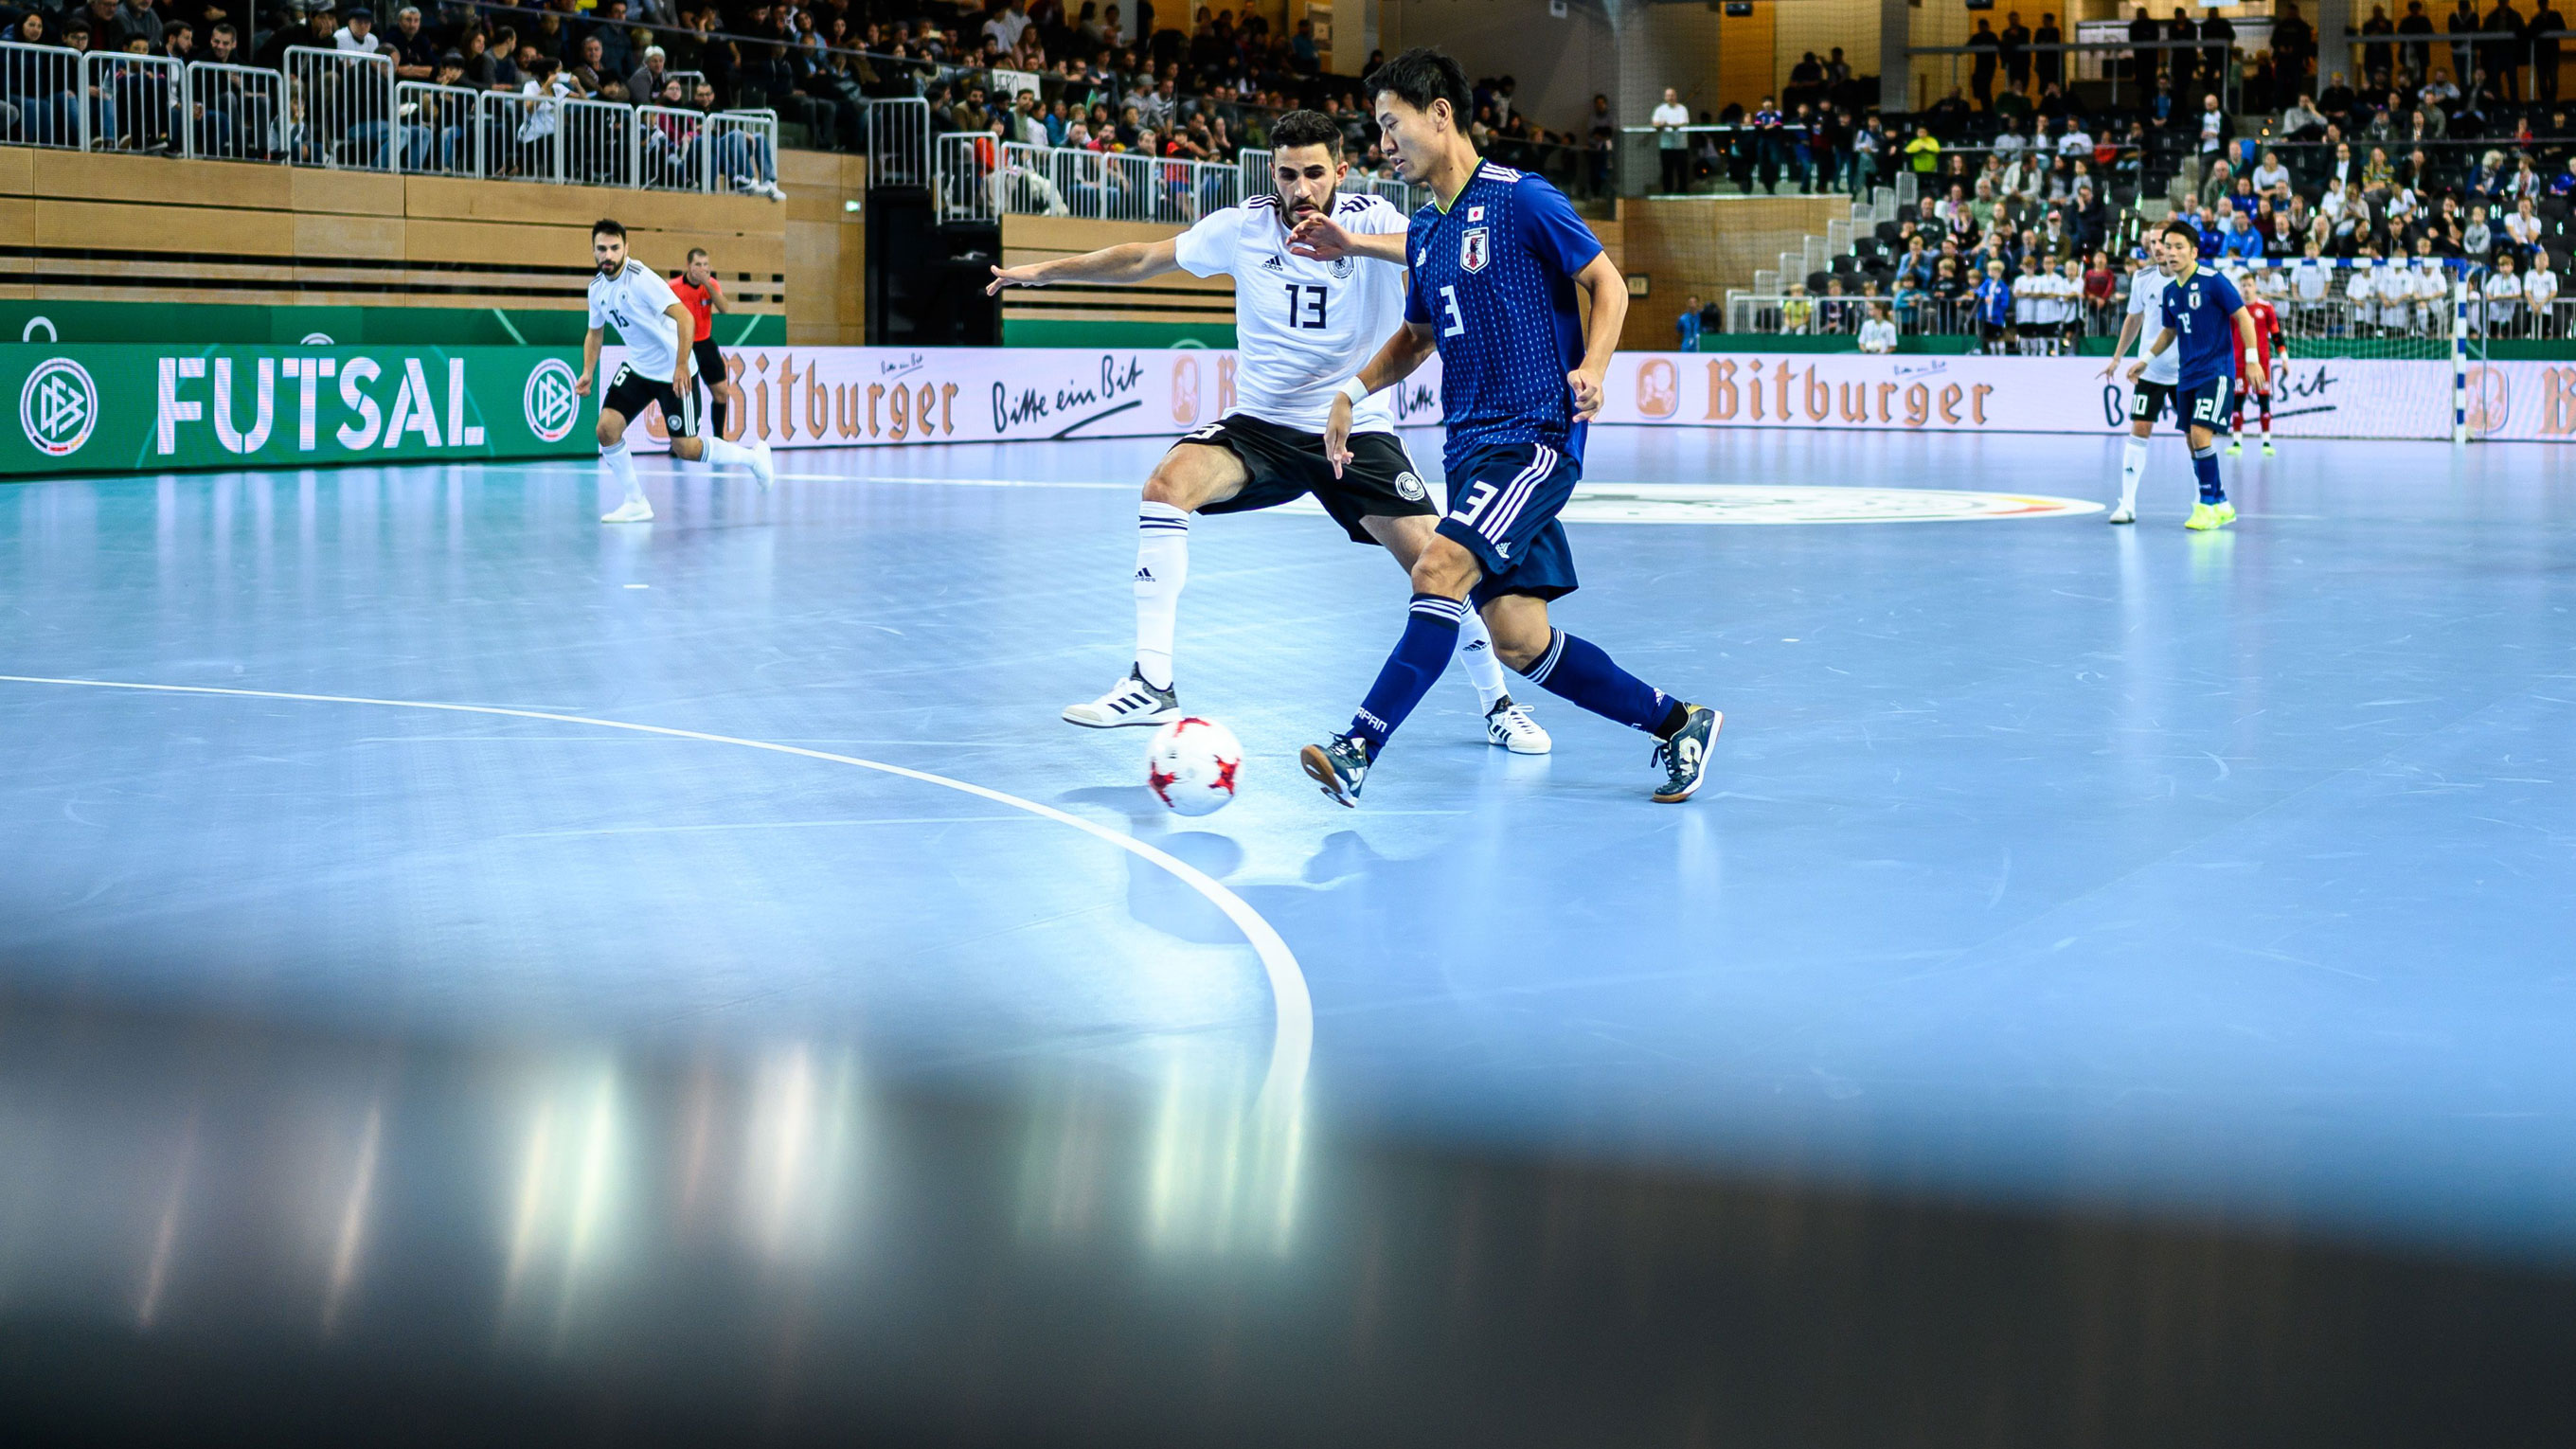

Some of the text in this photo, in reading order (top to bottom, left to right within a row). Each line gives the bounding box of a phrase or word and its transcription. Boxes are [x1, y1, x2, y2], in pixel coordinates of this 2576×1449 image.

[1285, 283, 1328, 330] 13
[1440, 284, 1465, 337] 3
[614, 366, 630, 387] 6
[722, 351, 960, 442] Bitburger
[993, 354, 1144, 434] Bitte ein Bit
[1703, 356, 1995, 428] Bitburger
[156, 356, 485, 456] FUTSAL
[2132, 394, 2149, 416] 10
[2192, 398, 2214, 421] 12
[1449, 479, 1499, 528] 3
[1356, 706, 1388, 734] APAN
